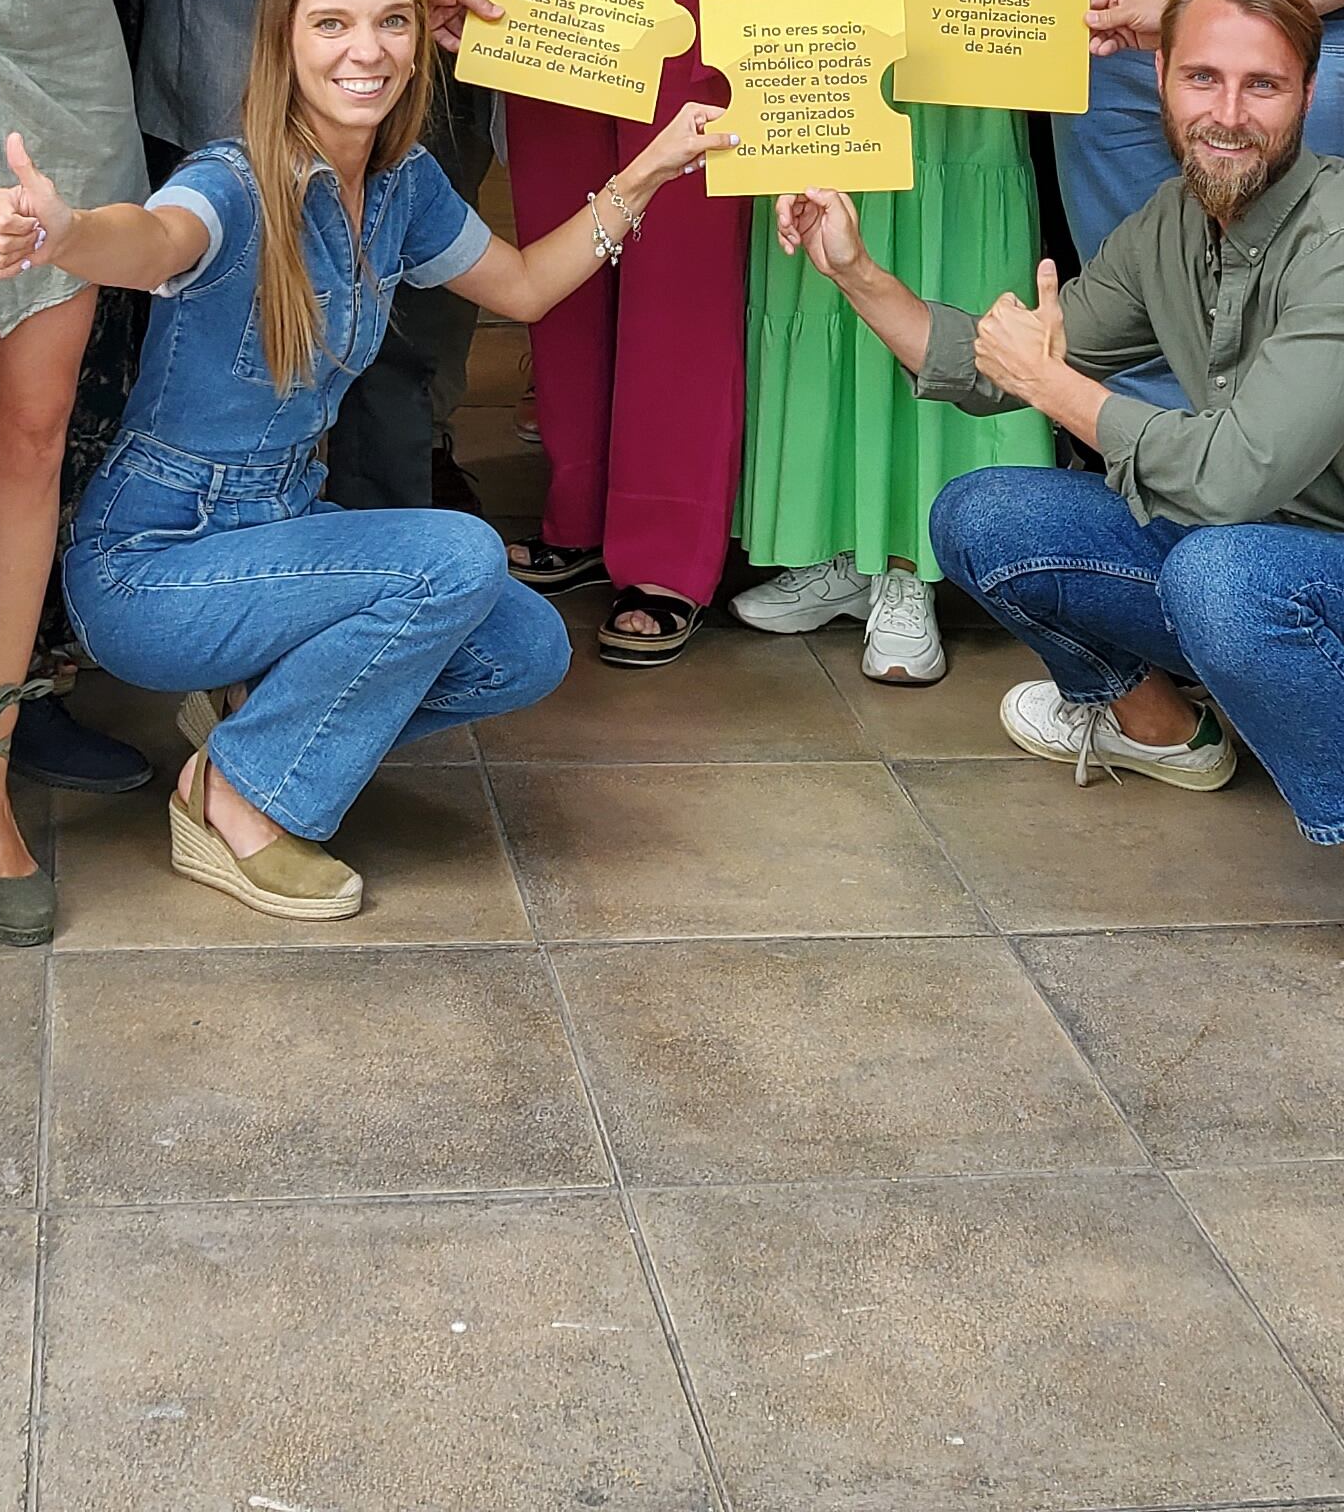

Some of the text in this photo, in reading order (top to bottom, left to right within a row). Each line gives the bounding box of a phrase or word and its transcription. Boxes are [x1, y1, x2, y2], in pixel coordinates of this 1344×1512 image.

[529, 8, 605, 33] andaluzas
[578, 3, 655, 28] provincias
[945, 7, 1056, 26] organizaciones
[507, 19, 621, 53] pertenecientes
[743, 21, 866, 38] Si no eres socio,
[940, 21, 1047, 41] de provincia
[535, 39, 618, 69] Federación
[753, 37, 857, 57] por un precio
[964, 39, 1022, 56] de Jaén
[470, 42, 645, 94] Andaluza de Marketing
[739, 54, 872, 72] simbólico podrás
[745, 72, 868, 88] acceder todos
[763, 91, 851, 105] los eventos
[760, 106, 855, 124] organizados
[767, 123, 851, 142] por el Club
[736, 139, 881, 157] de Marketing Jaén
